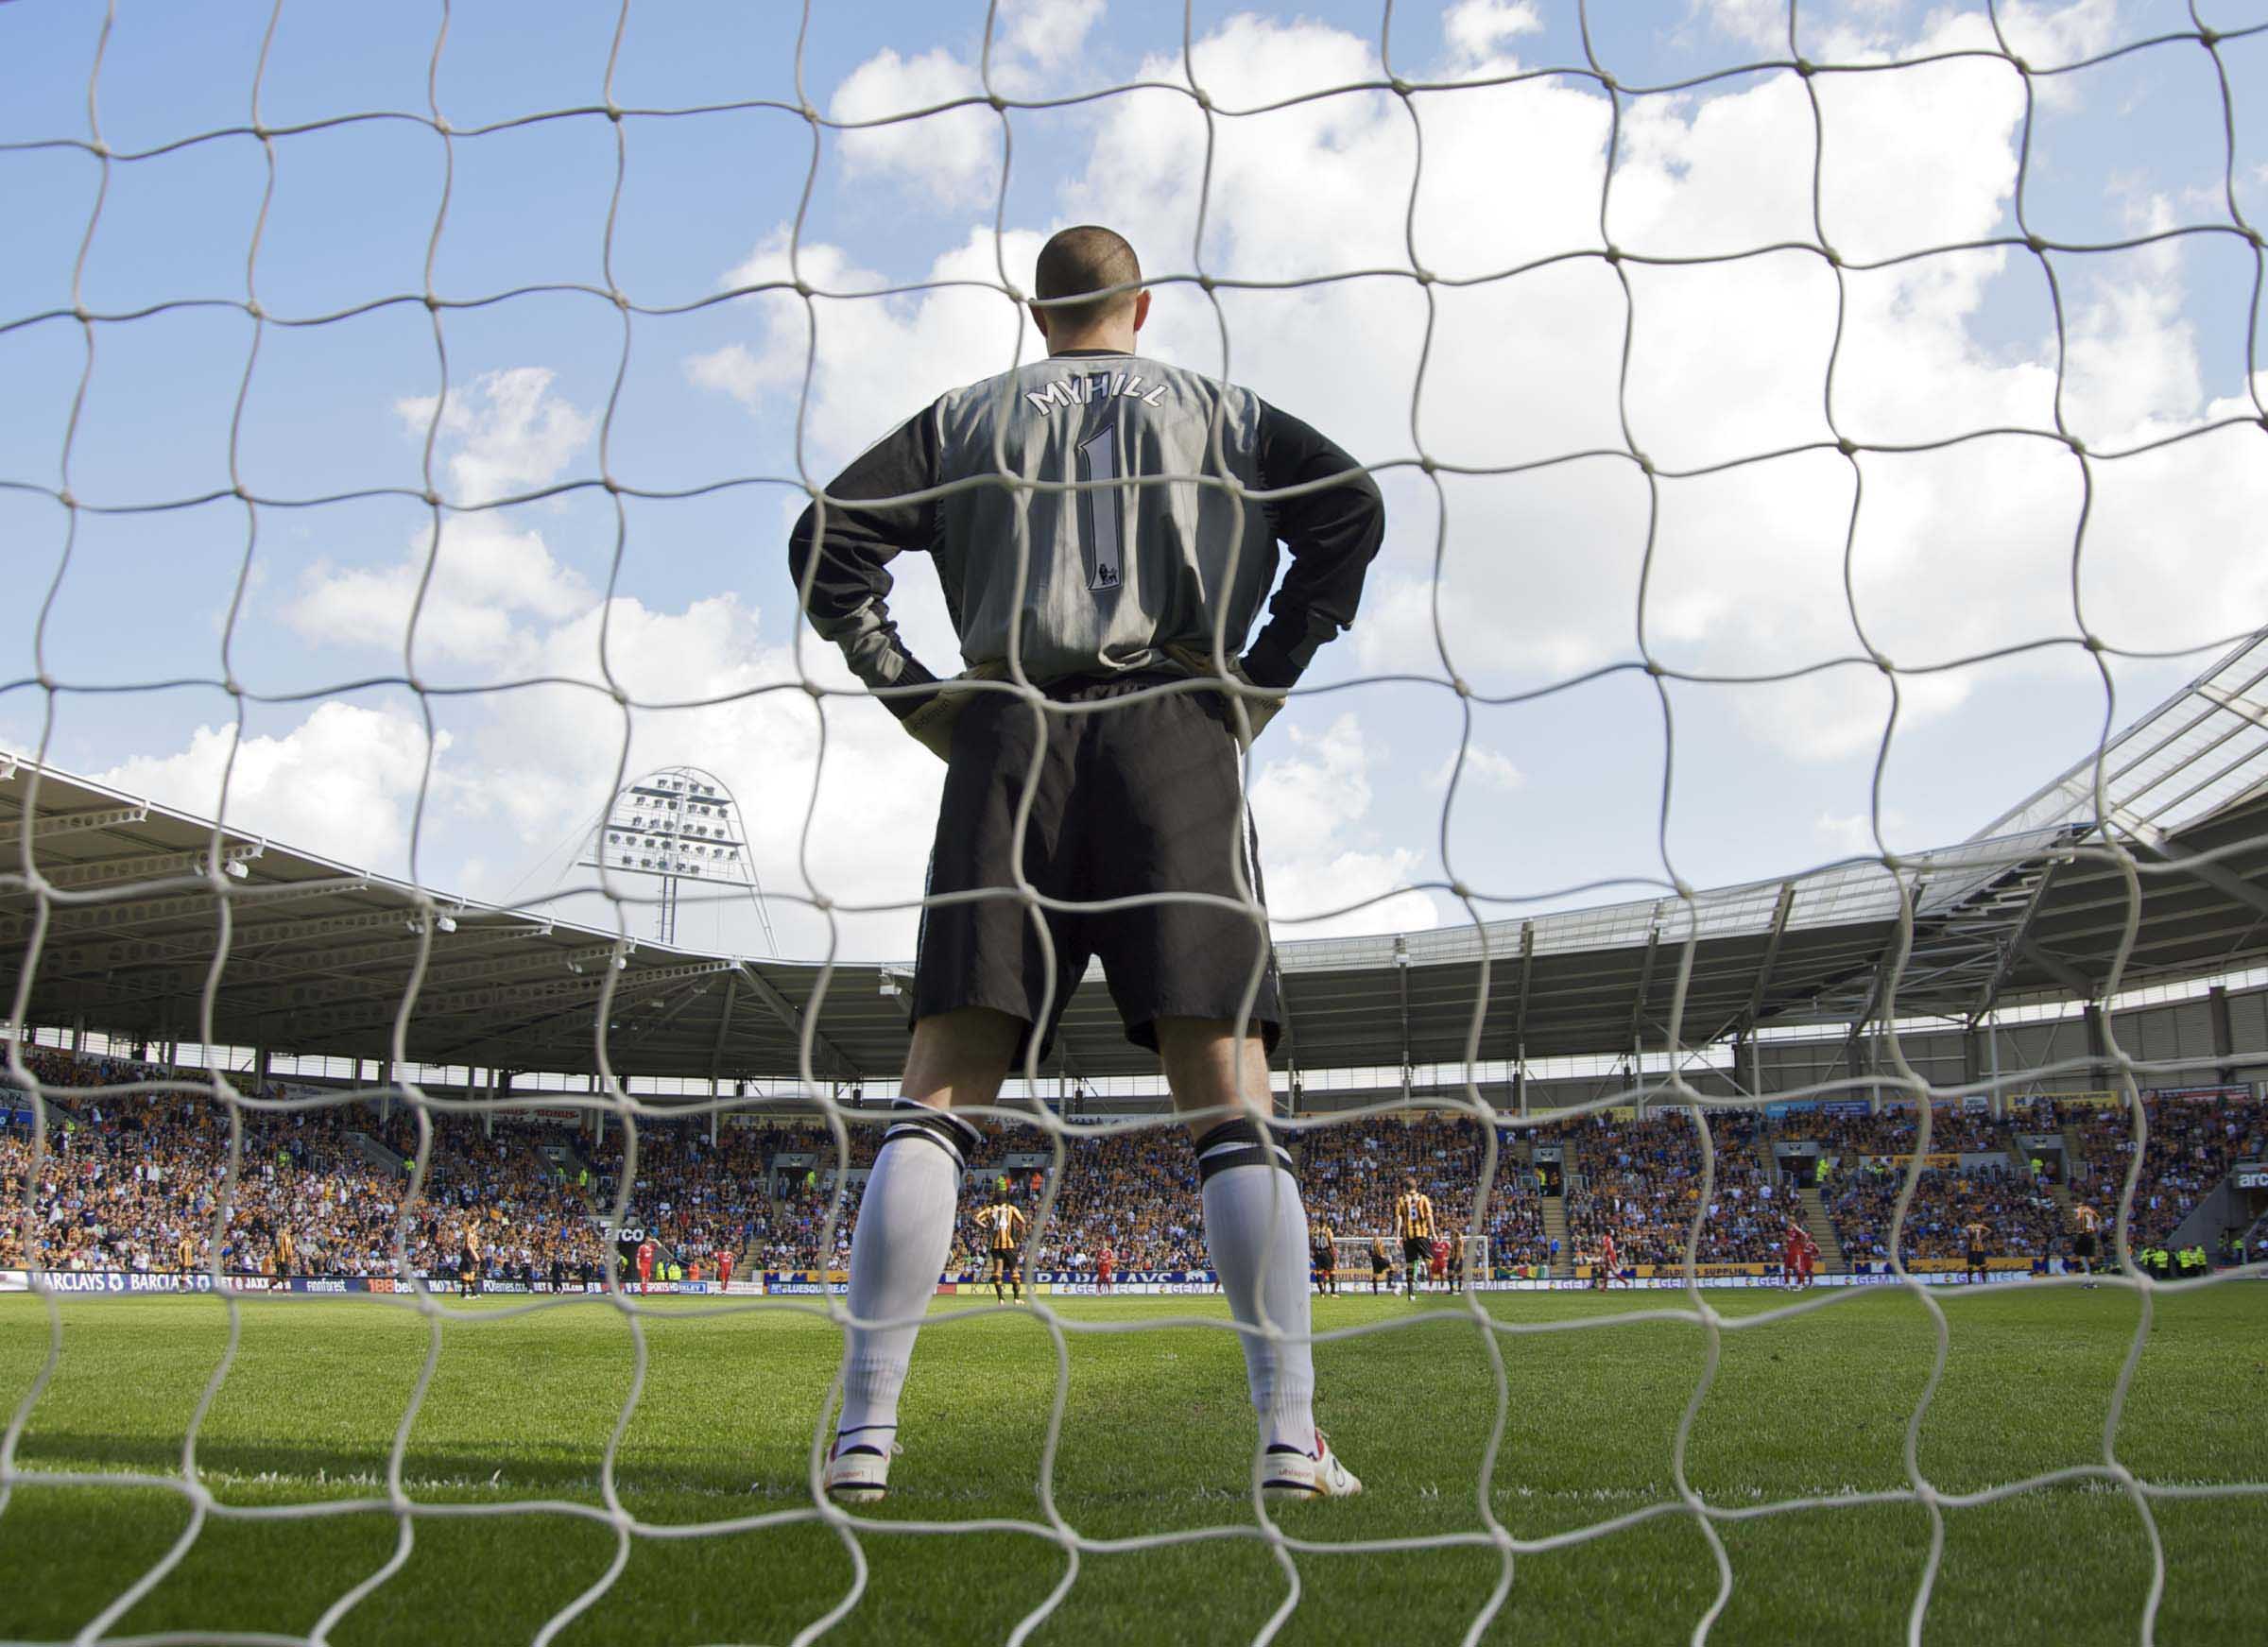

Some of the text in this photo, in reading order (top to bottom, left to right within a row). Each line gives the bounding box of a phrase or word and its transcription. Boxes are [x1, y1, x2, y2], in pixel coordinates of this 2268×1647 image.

[1025, 372, 1168, 416] MYHILL
[1078, 424, 1123, 592] 1
[605, 1228, 644, 1242] arco
